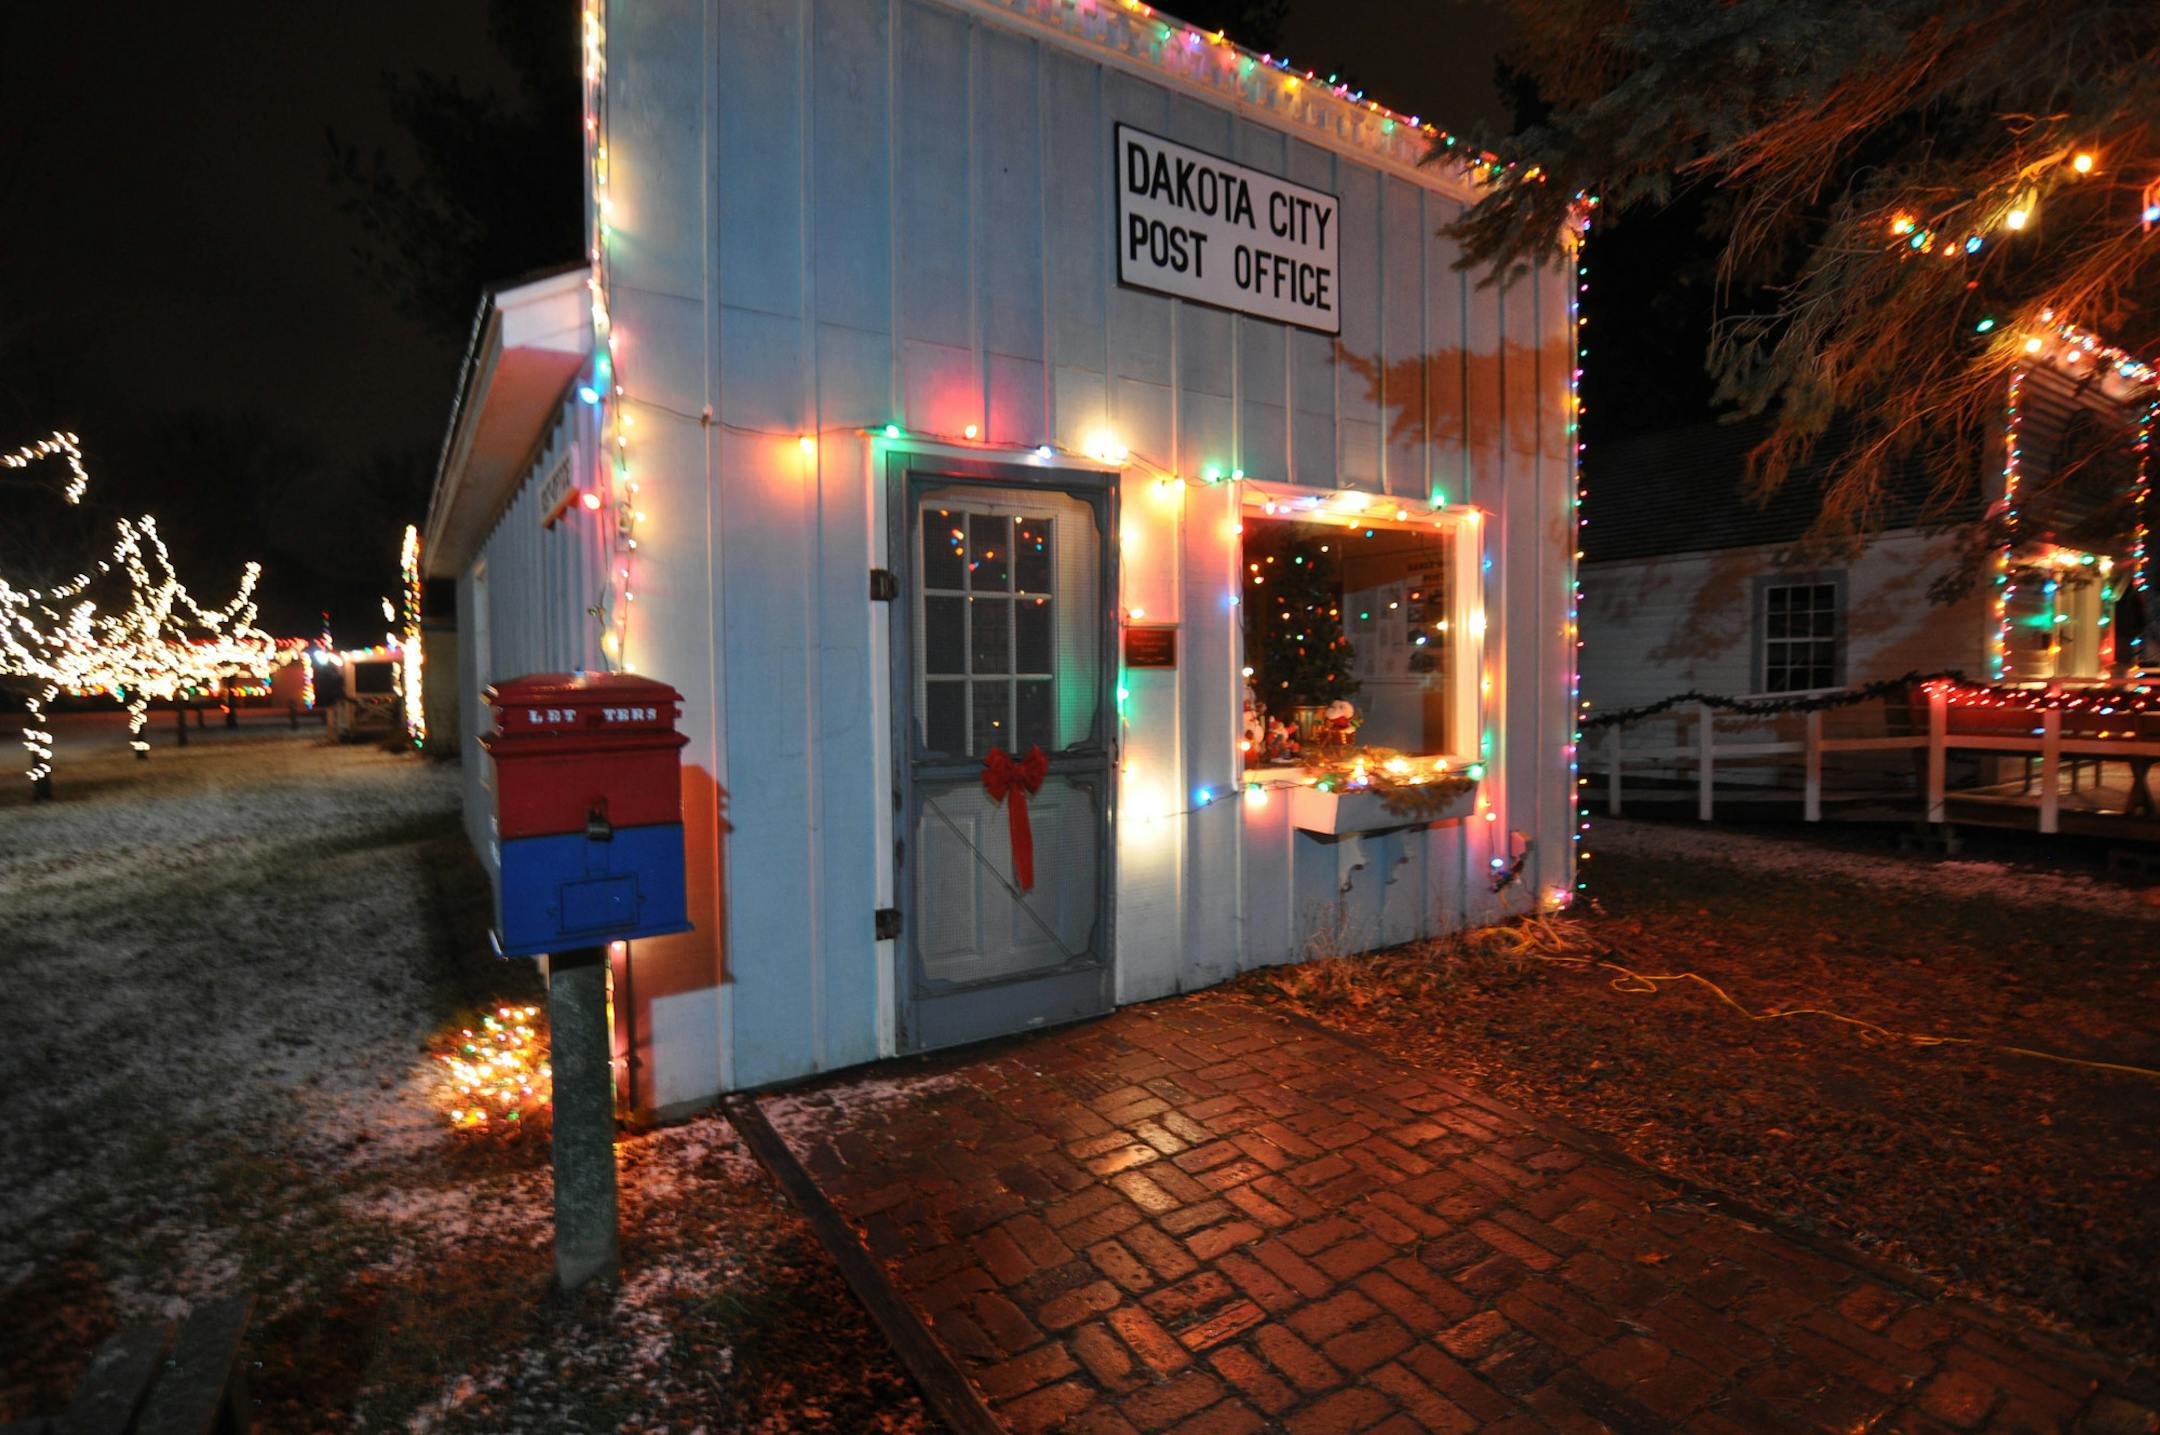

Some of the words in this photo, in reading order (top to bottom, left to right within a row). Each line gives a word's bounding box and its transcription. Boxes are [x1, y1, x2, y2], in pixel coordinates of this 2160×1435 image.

[1127, 141, 1256, 230] DAKOTA
[1269, 190, 1332, 250] CITY
[1129, 212, 1208, 278] POST
[1234, 244, 1331, 311] OFFICE
